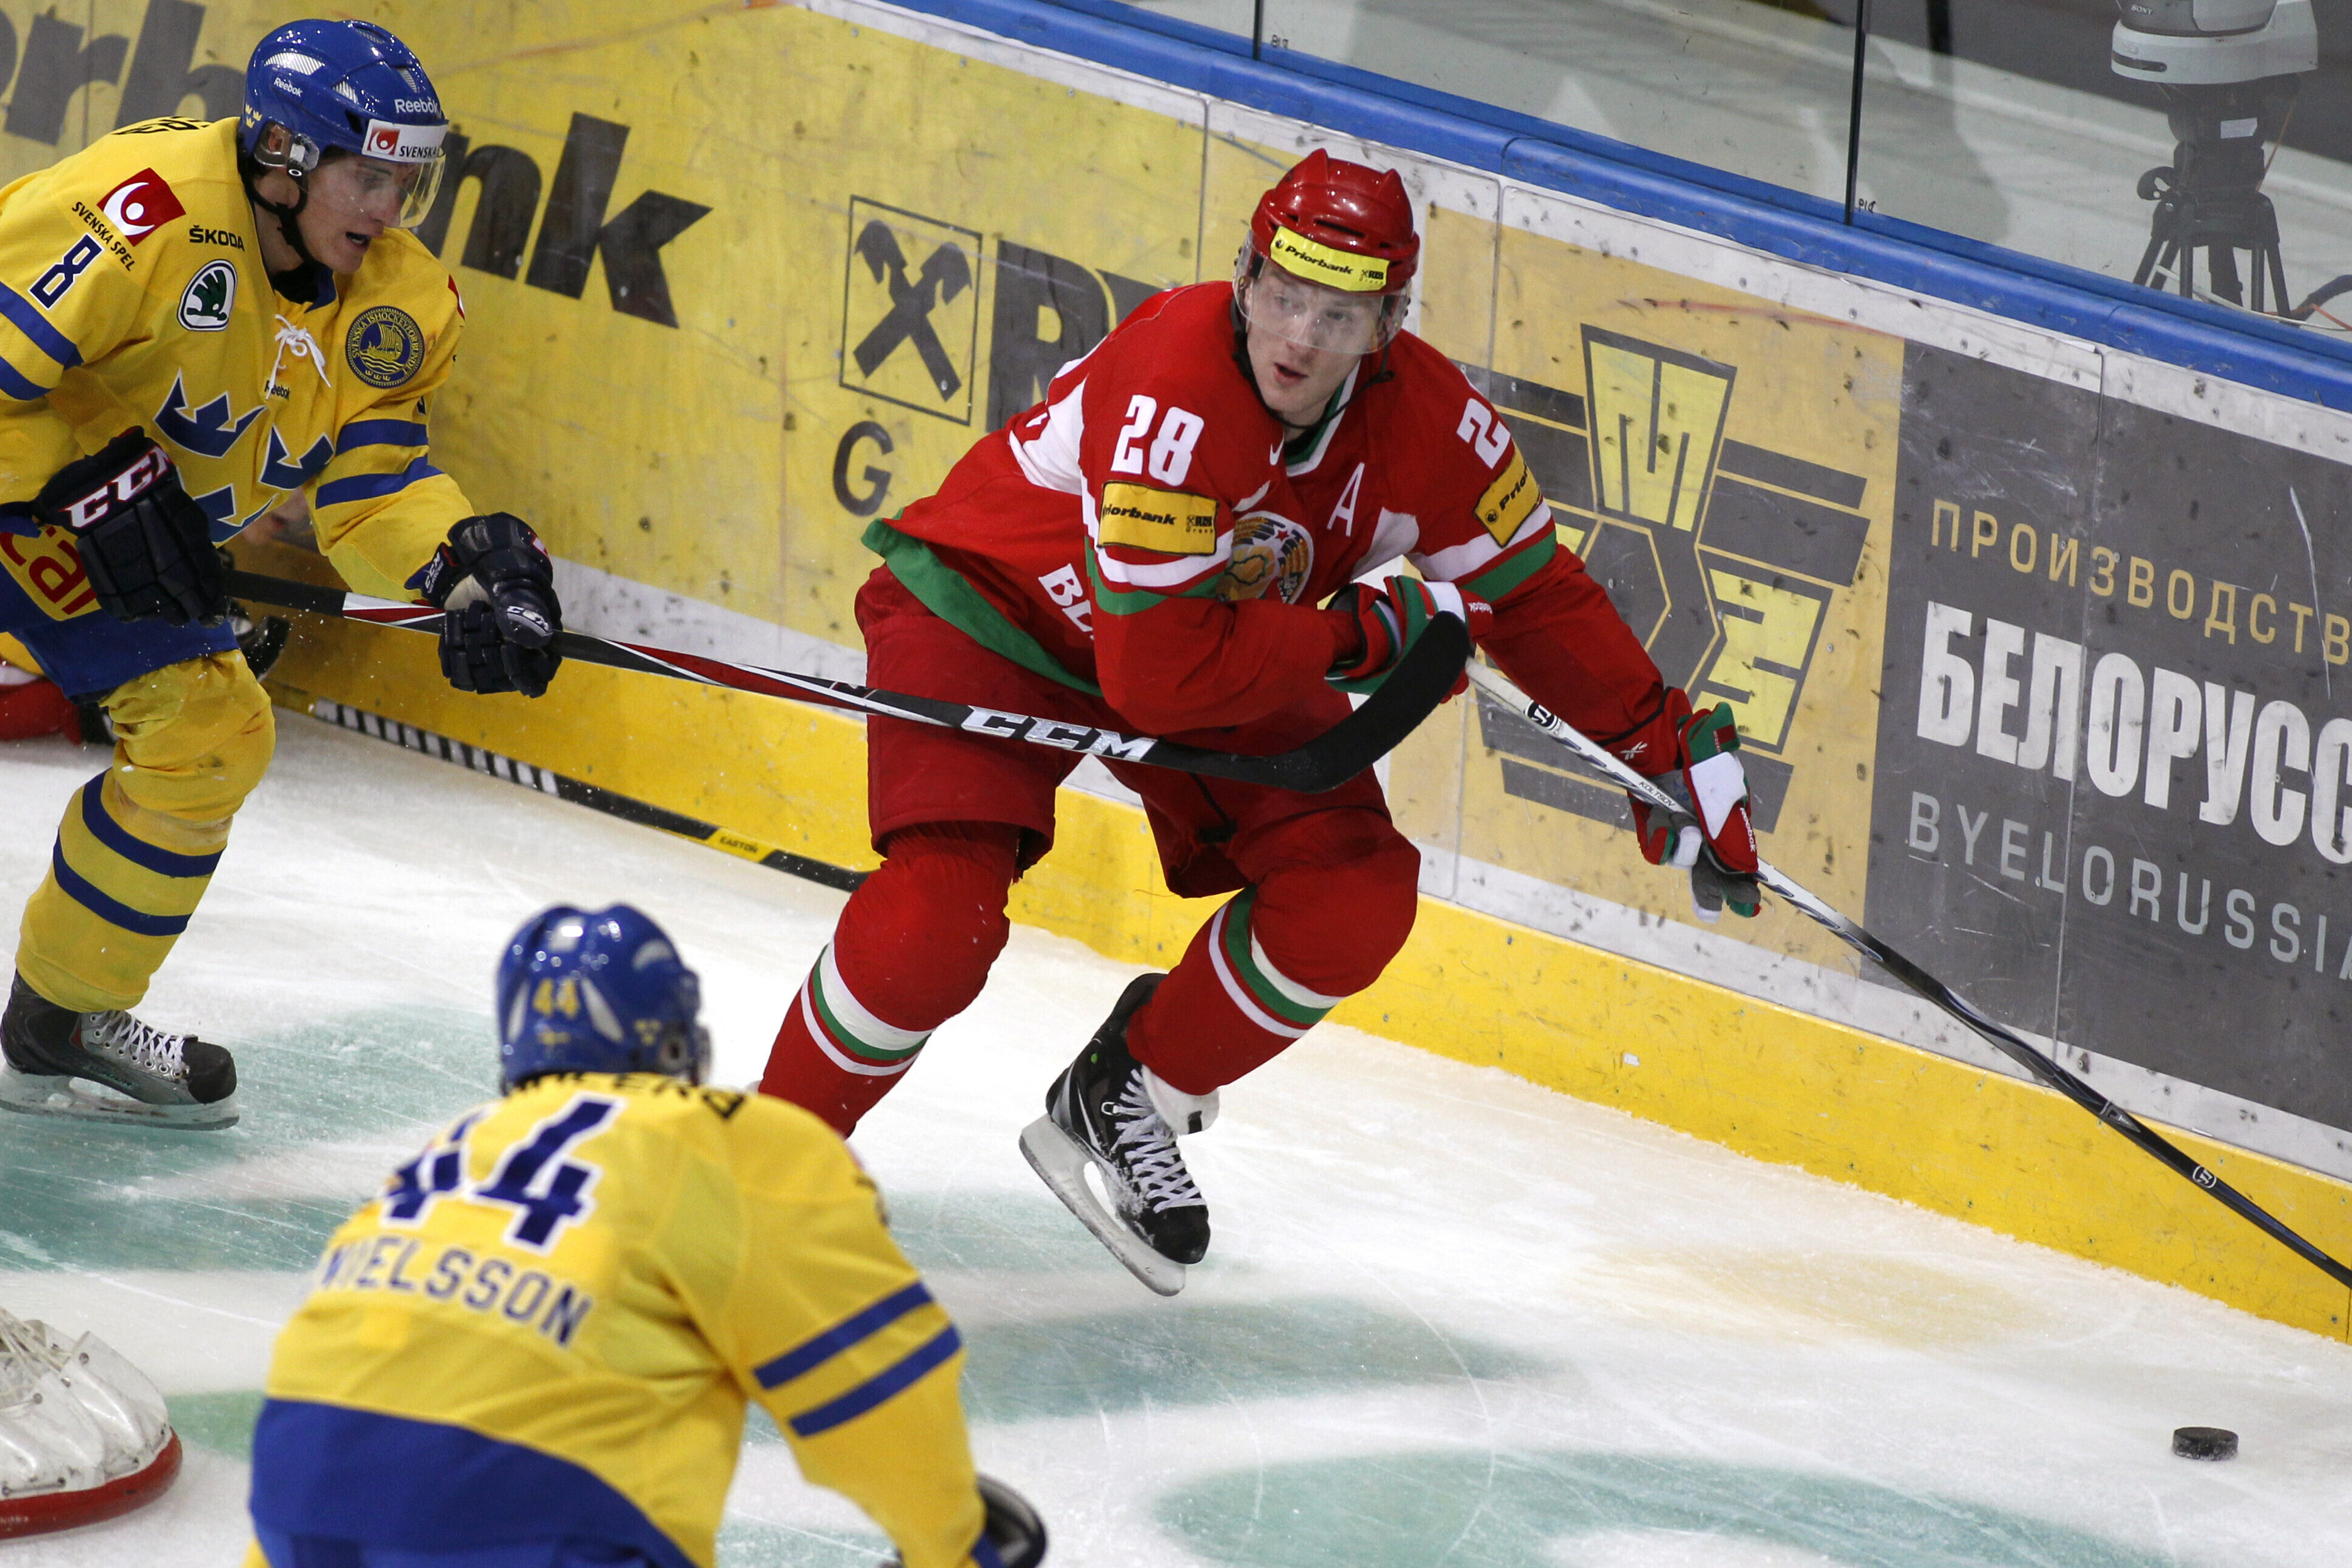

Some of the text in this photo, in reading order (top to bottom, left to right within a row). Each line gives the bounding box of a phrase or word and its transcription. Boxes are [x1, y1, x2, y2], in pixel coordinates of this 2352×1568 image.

[2131, 4, 2154, 15] SONY
[274, 77, 303, 98] Reebok
[394, 98, 440, 115] Reebok
[399, 146, 438, 159] SVENSKA
[71, 201, 137, 272] SVENSKA SPEL
[189, 224, 245, 251] ŠKODA
[27, 232, 105, 310] 8
[1285, 245, 1353, 275] Priorbank
[1110, 394, 1205, 487] 28
[1327, 463, 1364, 537] A
[1931, 498, 2351, 666] ПРОИЗВОДСТВ
[960, 704, 1158, 762] CCM
[1638, 781, 1676, 806] KOLTSOV
[532, 976, 581, 1020] 44
